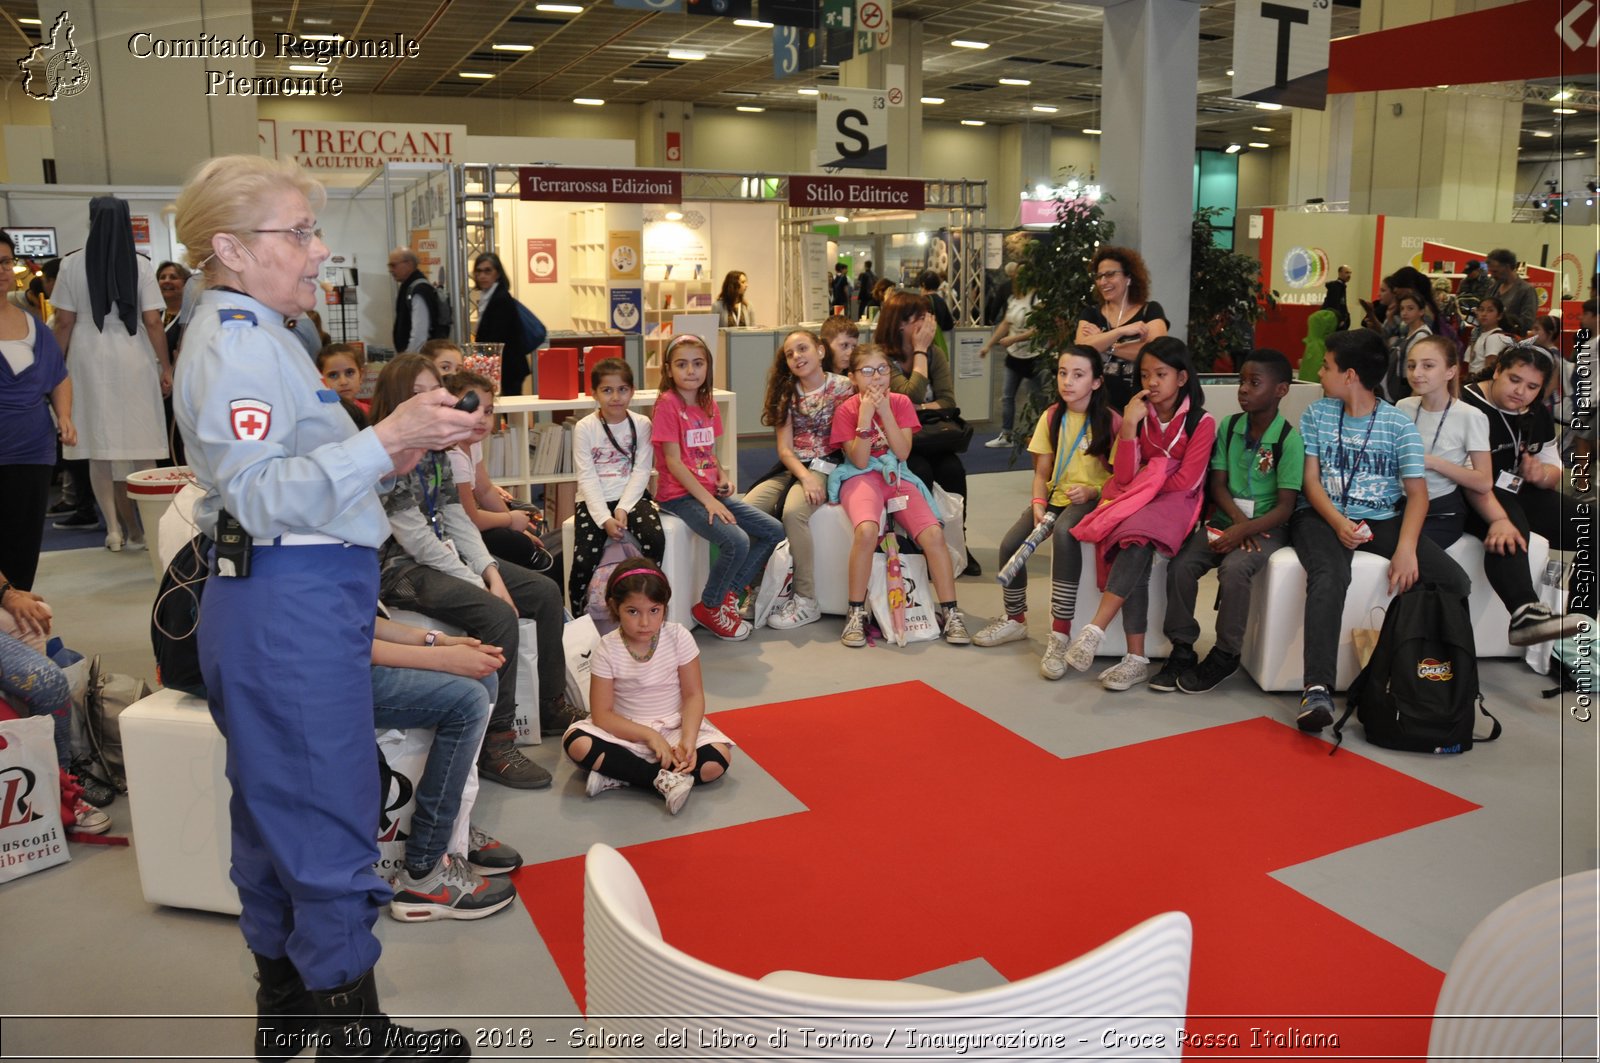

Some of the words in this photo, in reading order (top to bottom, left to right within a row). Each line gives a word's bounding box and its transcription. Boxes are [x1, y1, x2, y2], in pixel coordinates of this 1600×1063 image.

[1261, 2, 1309, 89] T
[292, 129, 453, 156] TRECCANI
[835, 108, 869, 160] S
[316, 156, 384, 168] CULTURA
[529, 176, 608, 193] Terrarossa
[611, 178, 673, 195] Edizioni
[806, 183, 844, 201] Stilo
[849, 185, 909, 203] Editrice
